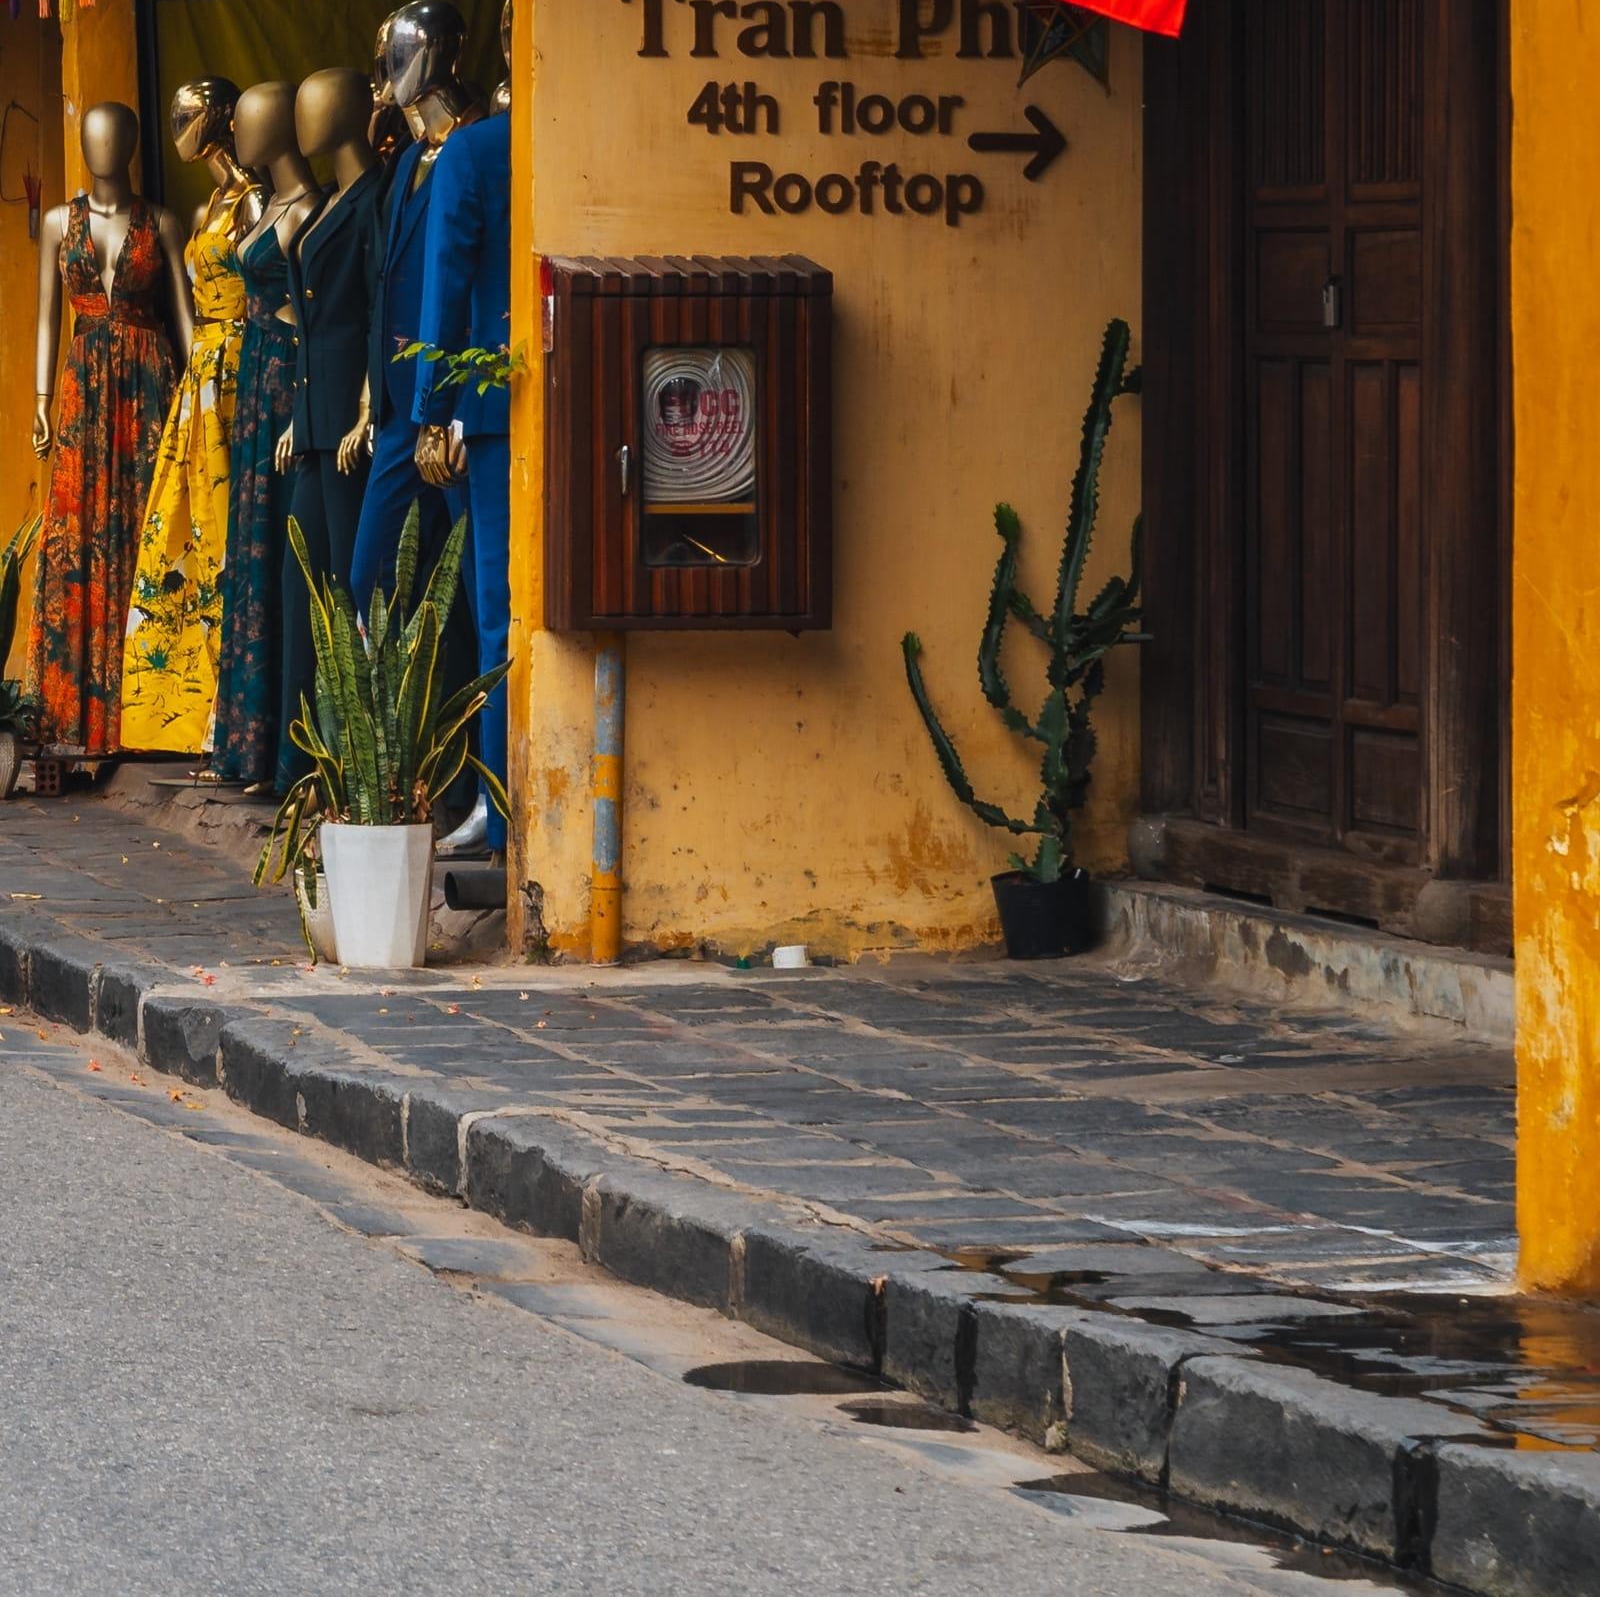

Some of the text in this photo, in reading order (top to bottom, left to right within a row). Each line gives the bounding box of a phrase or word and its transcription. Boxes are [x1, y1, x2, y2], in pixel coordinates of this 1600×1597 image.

[687, 80, 965, 135] 4th floor
[729, 160, 985, 227] Rooftop
